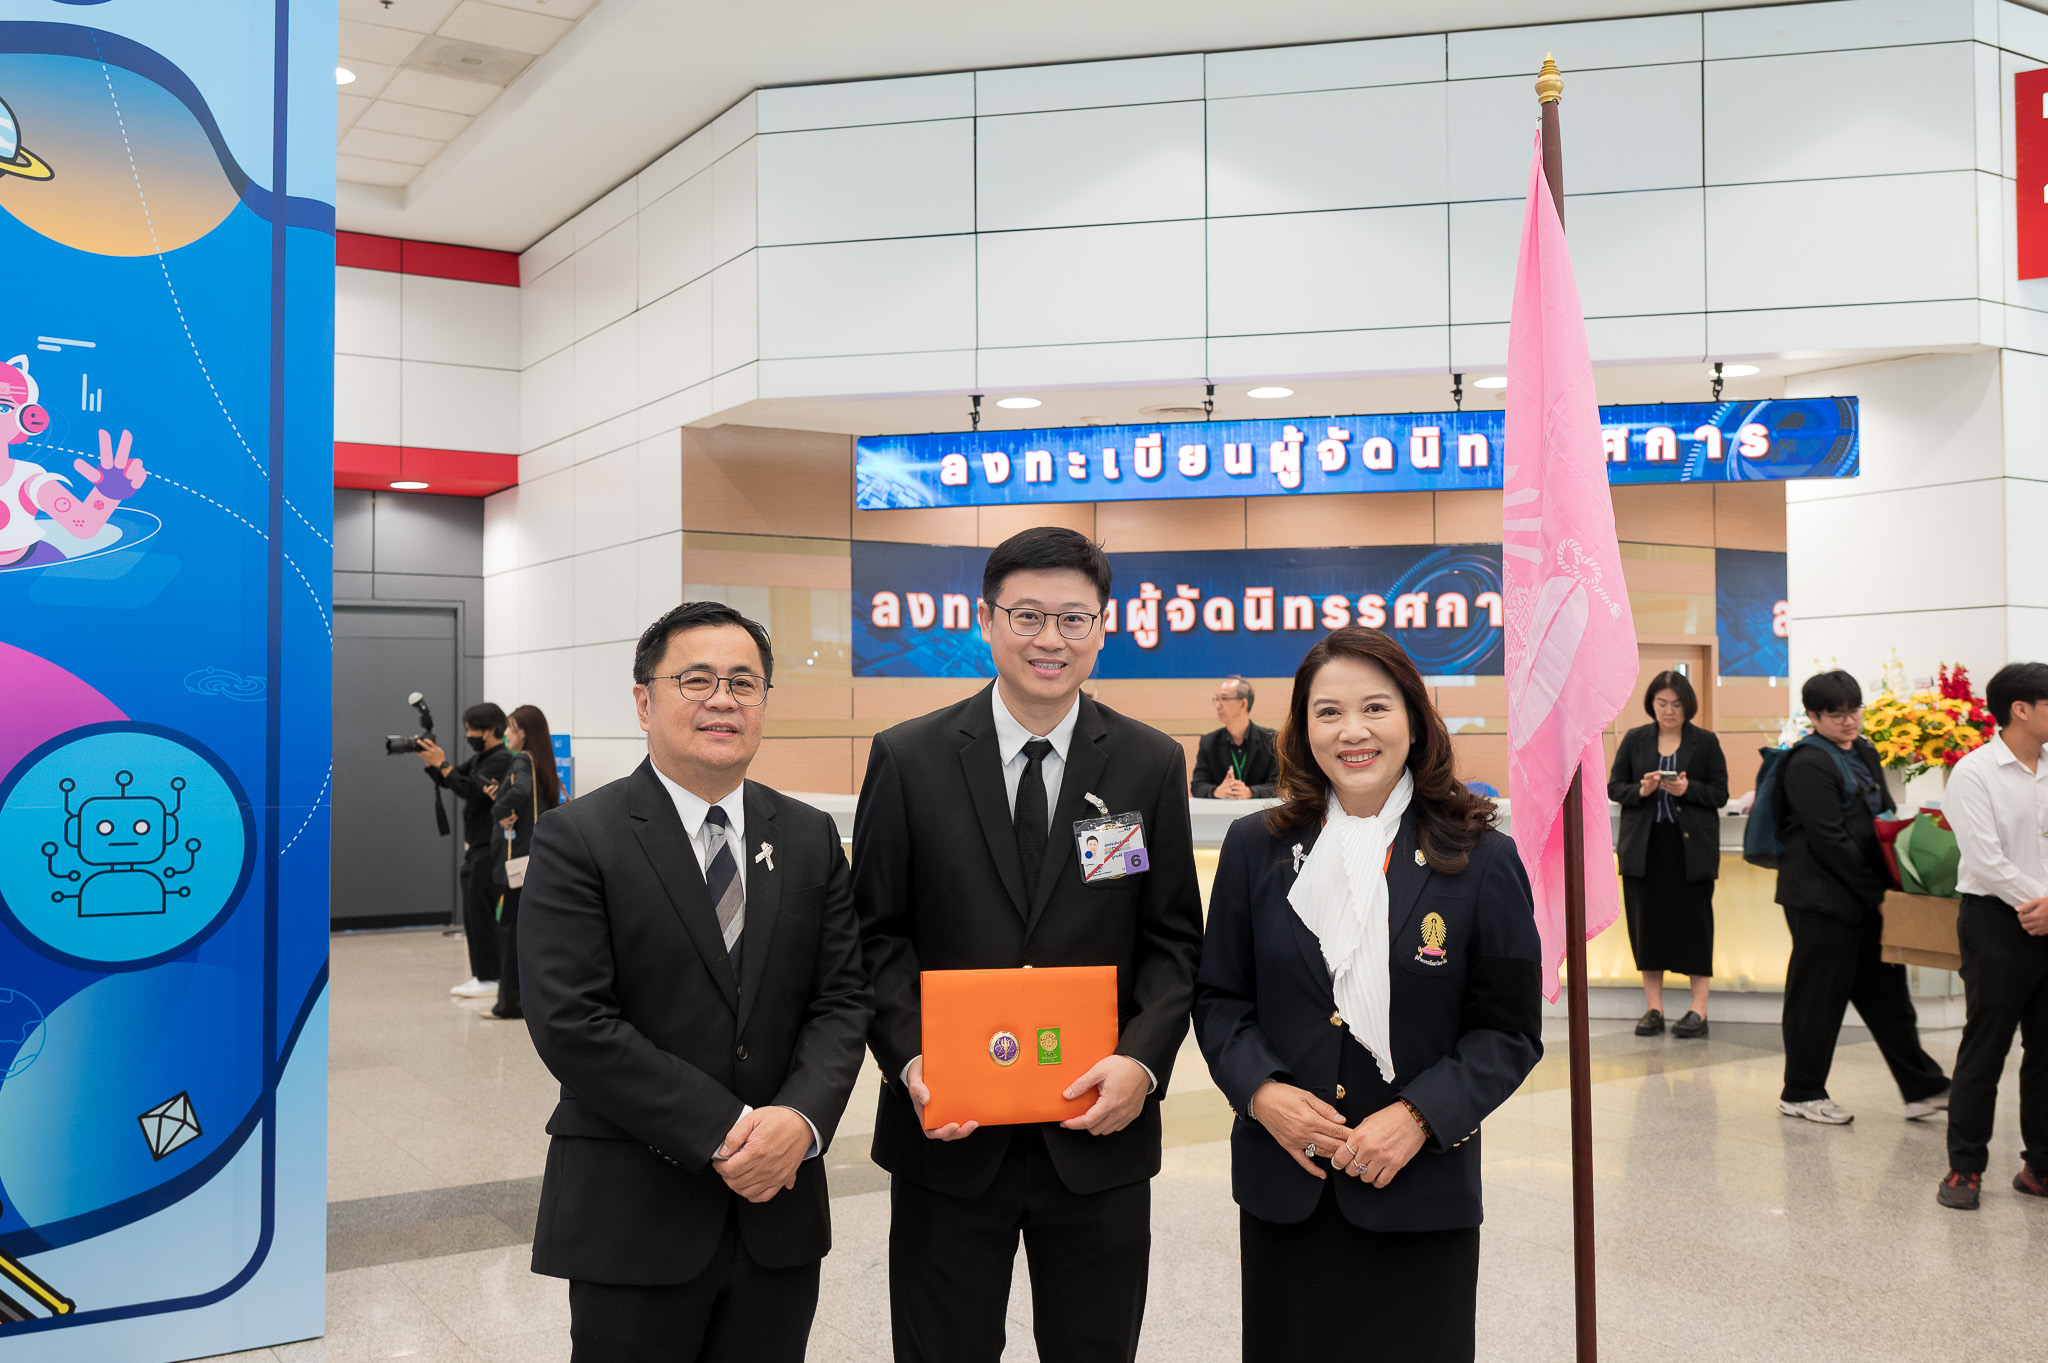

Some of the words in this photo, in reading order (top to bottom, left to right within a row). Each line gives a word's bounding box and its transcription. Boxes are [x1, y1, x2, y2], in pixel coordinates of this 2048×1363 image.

[940, 423, 1769, 488] ลงทะเบียนผู้จัดนิทศการ
[1131, 854, 1142, 867] 6
